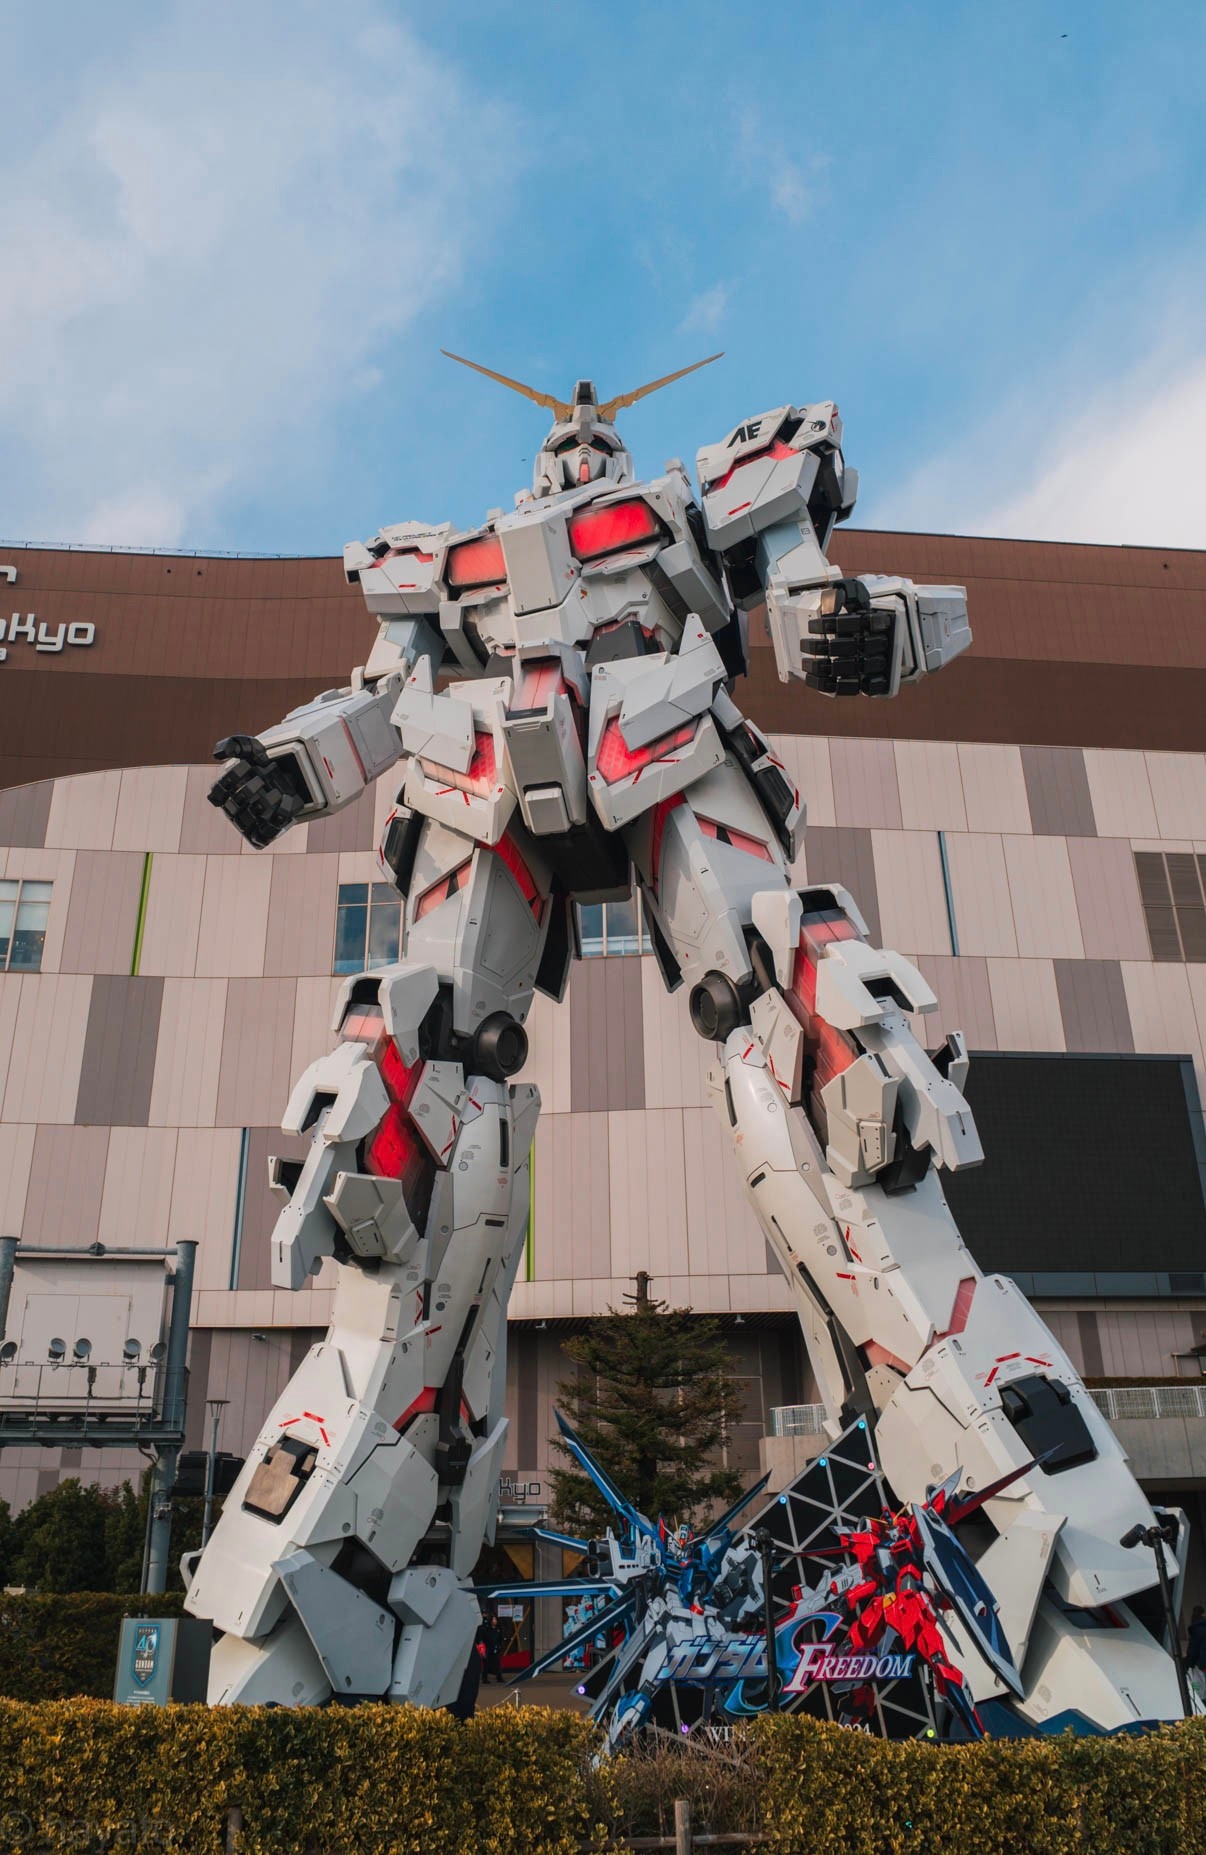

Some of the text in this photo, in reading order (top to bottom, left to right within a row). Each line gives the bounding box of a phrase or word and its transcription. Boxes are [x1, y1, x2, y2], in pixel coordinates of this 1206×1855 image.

[727, 420, 762, 448] AE
[0, 613, 95, 652] Kyo
[656, 1635, 768, 1680] ガンダム
[784, 1643, 915, 1692] FREEDOM
